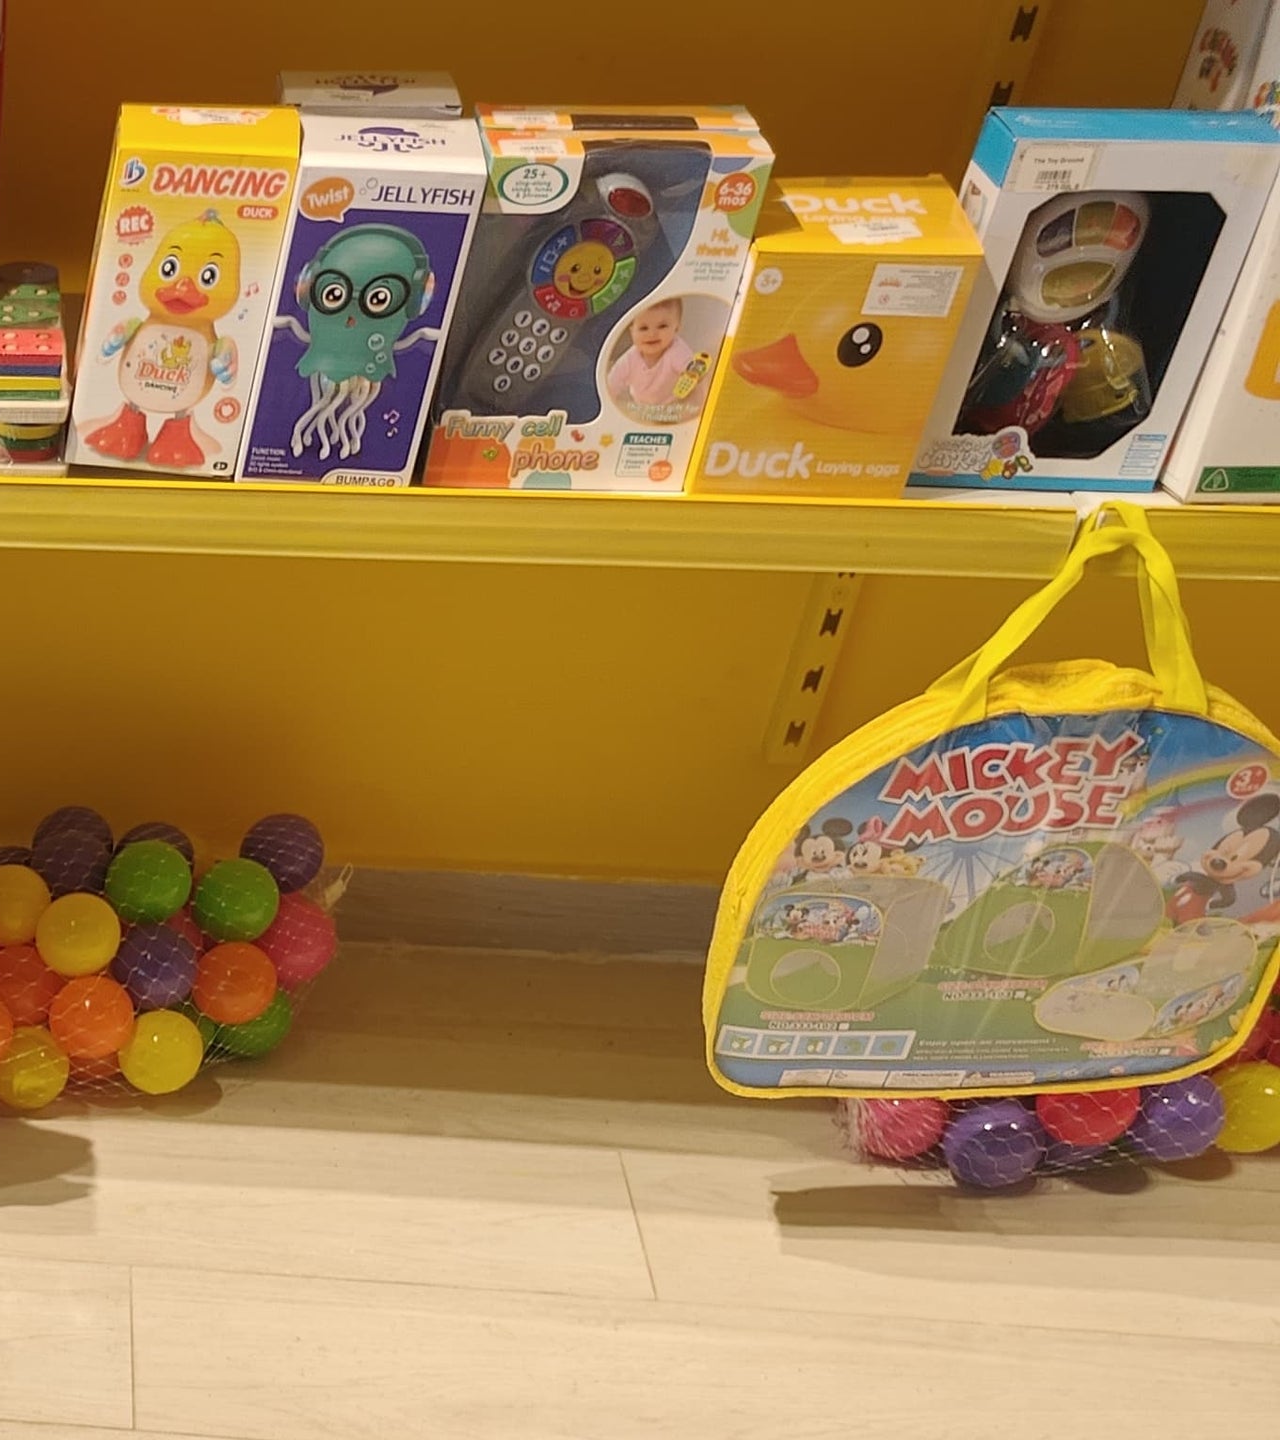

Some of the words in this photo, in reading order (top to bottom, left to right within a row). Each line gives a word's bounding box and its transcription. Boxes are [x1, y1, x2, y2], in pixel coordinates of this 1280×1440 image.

[152, 166, 287, 199] DANCING
[719, 182, 753, 195] 6-36
[307, 184, 351, 210] Twist
[371, 184, 476, 206] JELLYFISH
[718, 196, 747, 206] mos
[119, 213, 149, 234] REC
[242, 207, 273, 218] DUCK
[136, 362, 189, 384] Duck
[445, 416, 515, 442] Funny
[520, 414, 564, 438] cell
[628, 434, 669, 445] TEACHES
[511, 443, 600, 478] phone
[705, 440, 814, 479] Duck
[816, 460, 862, 476] Laying
[865, 461, 900, 476] eggs
[880, 732, 1142, 801] MICKEY
[880, 785, 1128, 846] MOUSE
